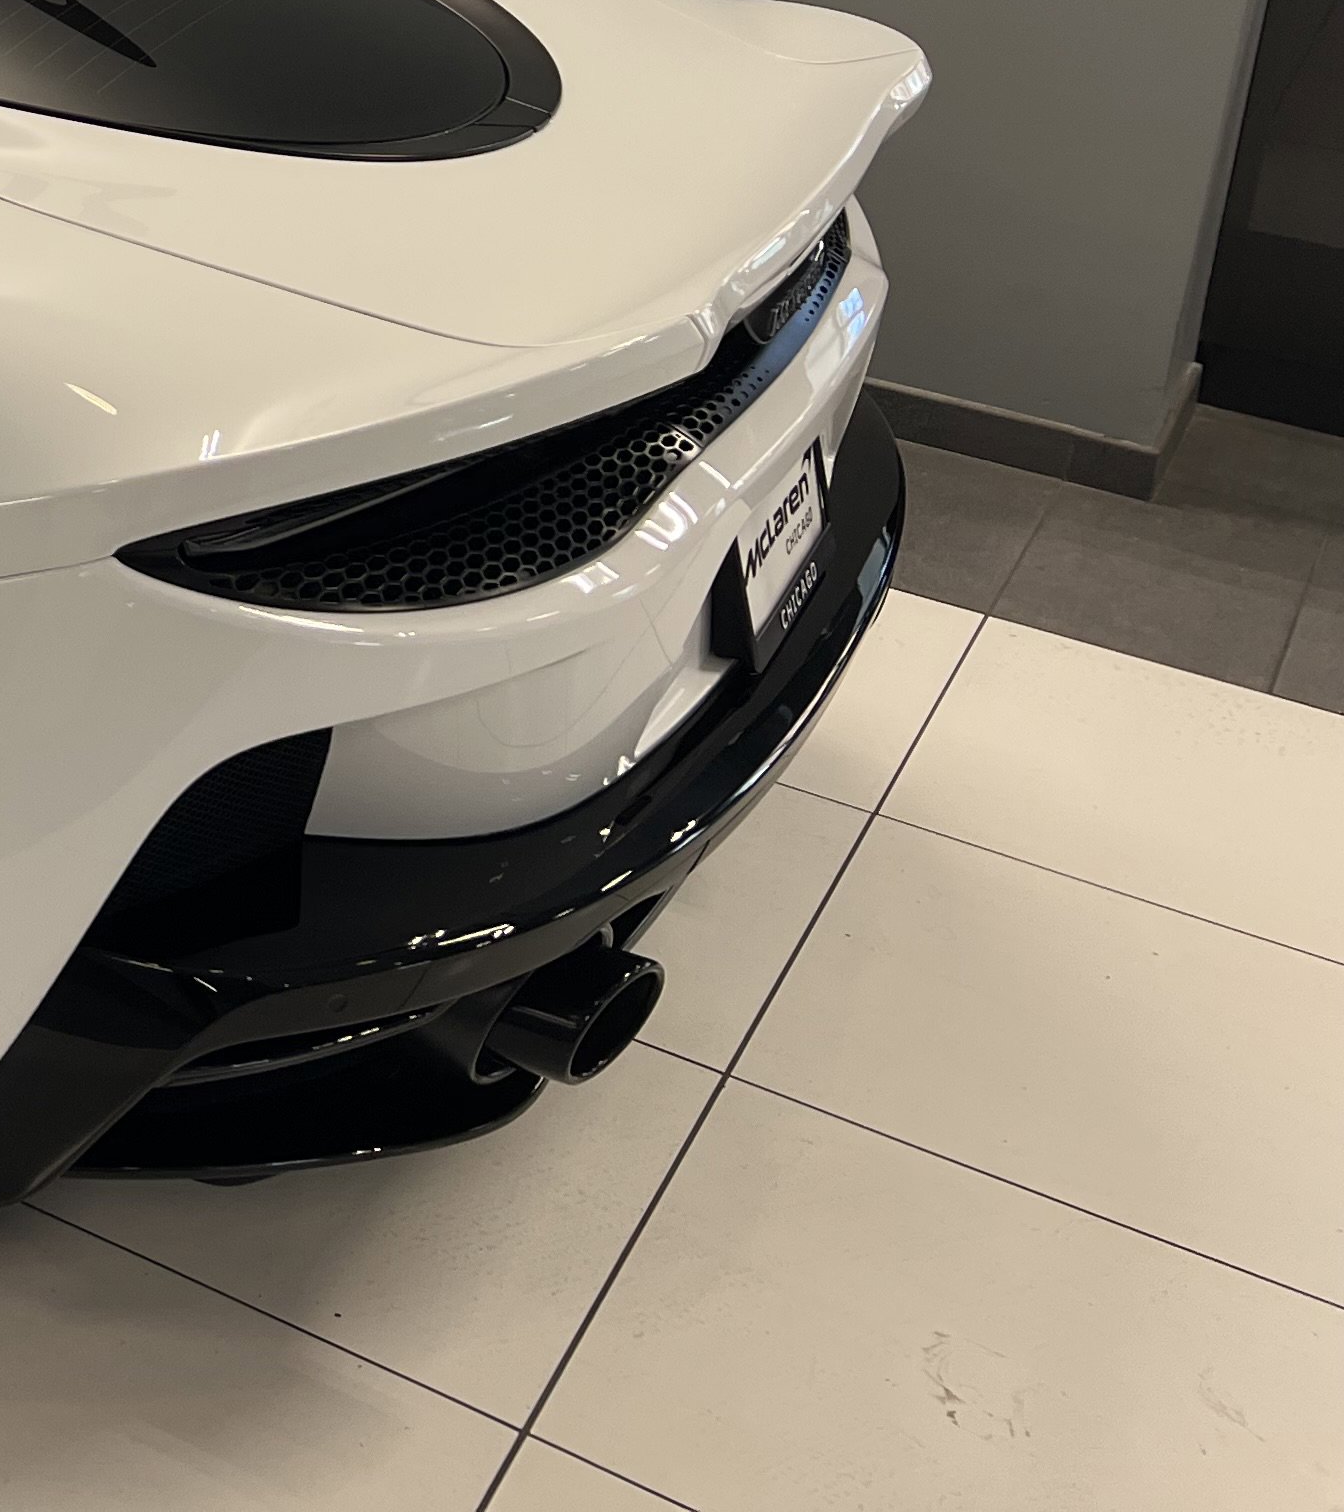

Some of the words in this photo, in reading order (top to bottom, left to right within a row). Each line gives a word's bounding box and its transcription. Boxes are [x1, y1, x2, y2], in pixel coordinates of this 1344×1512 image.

[745, 472, 810, 586] McLaren
[785, 506, 814, 555] CHICAGO
[780, 561, 818, 630] CHICAGO
